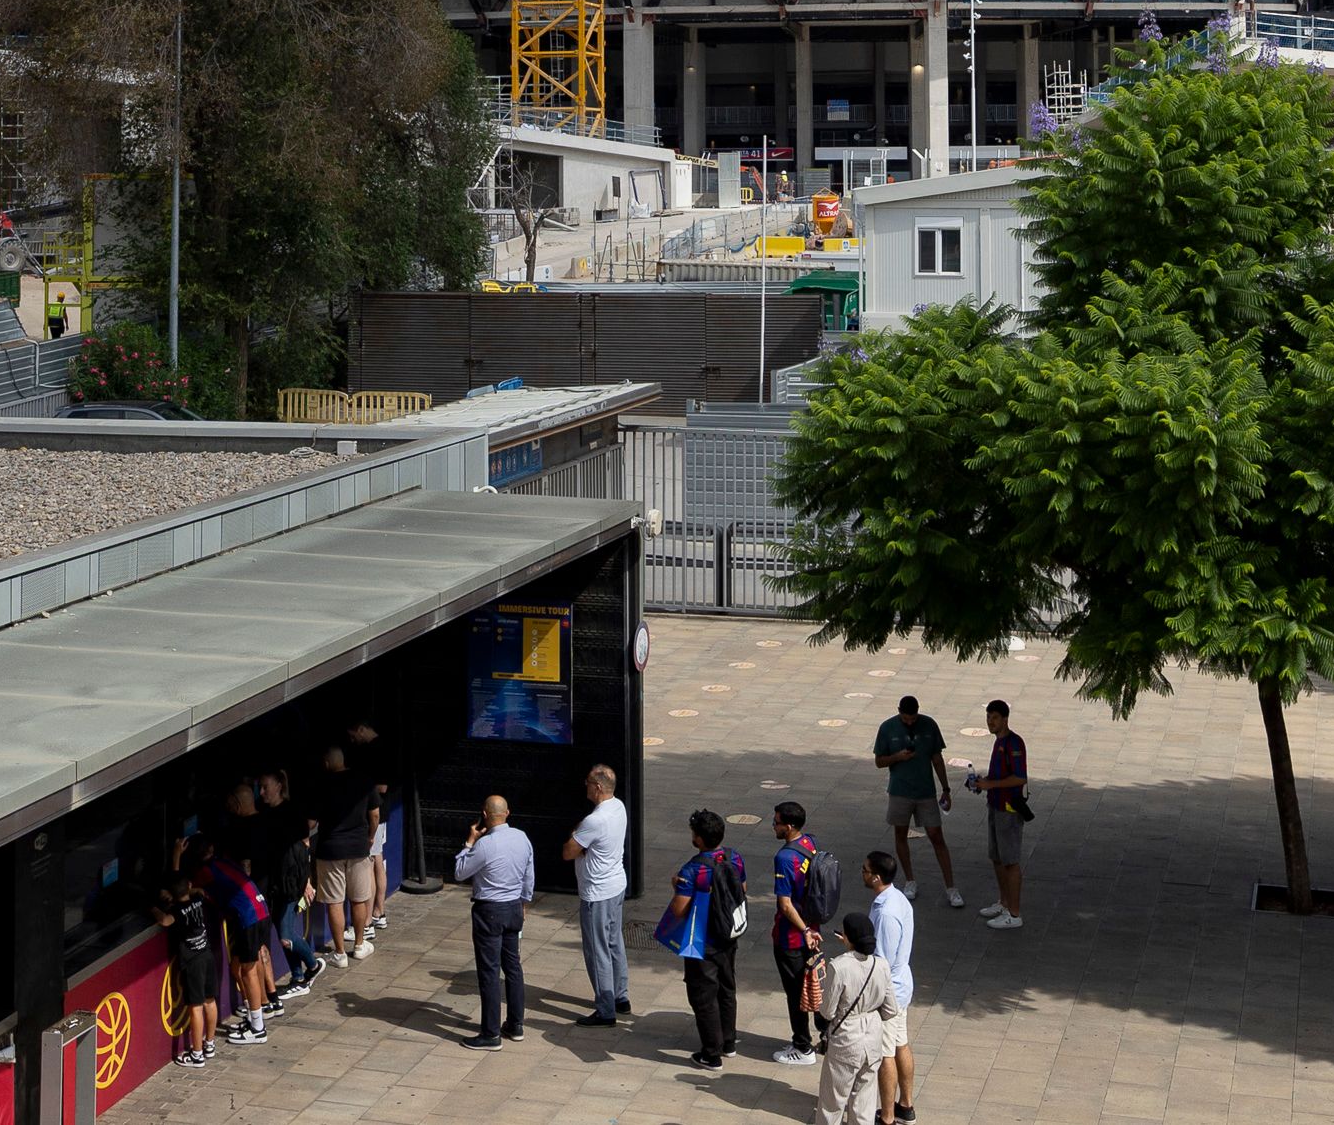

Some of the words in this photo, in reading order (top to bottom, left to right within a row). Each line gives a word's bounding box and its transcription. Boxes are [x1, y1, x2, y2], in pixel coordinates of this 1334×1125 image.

[751, 150, 761, 158] 41
[498, 604, 546, 614] IMMERSIVE
[548, 607, 570, 616] TOUR
